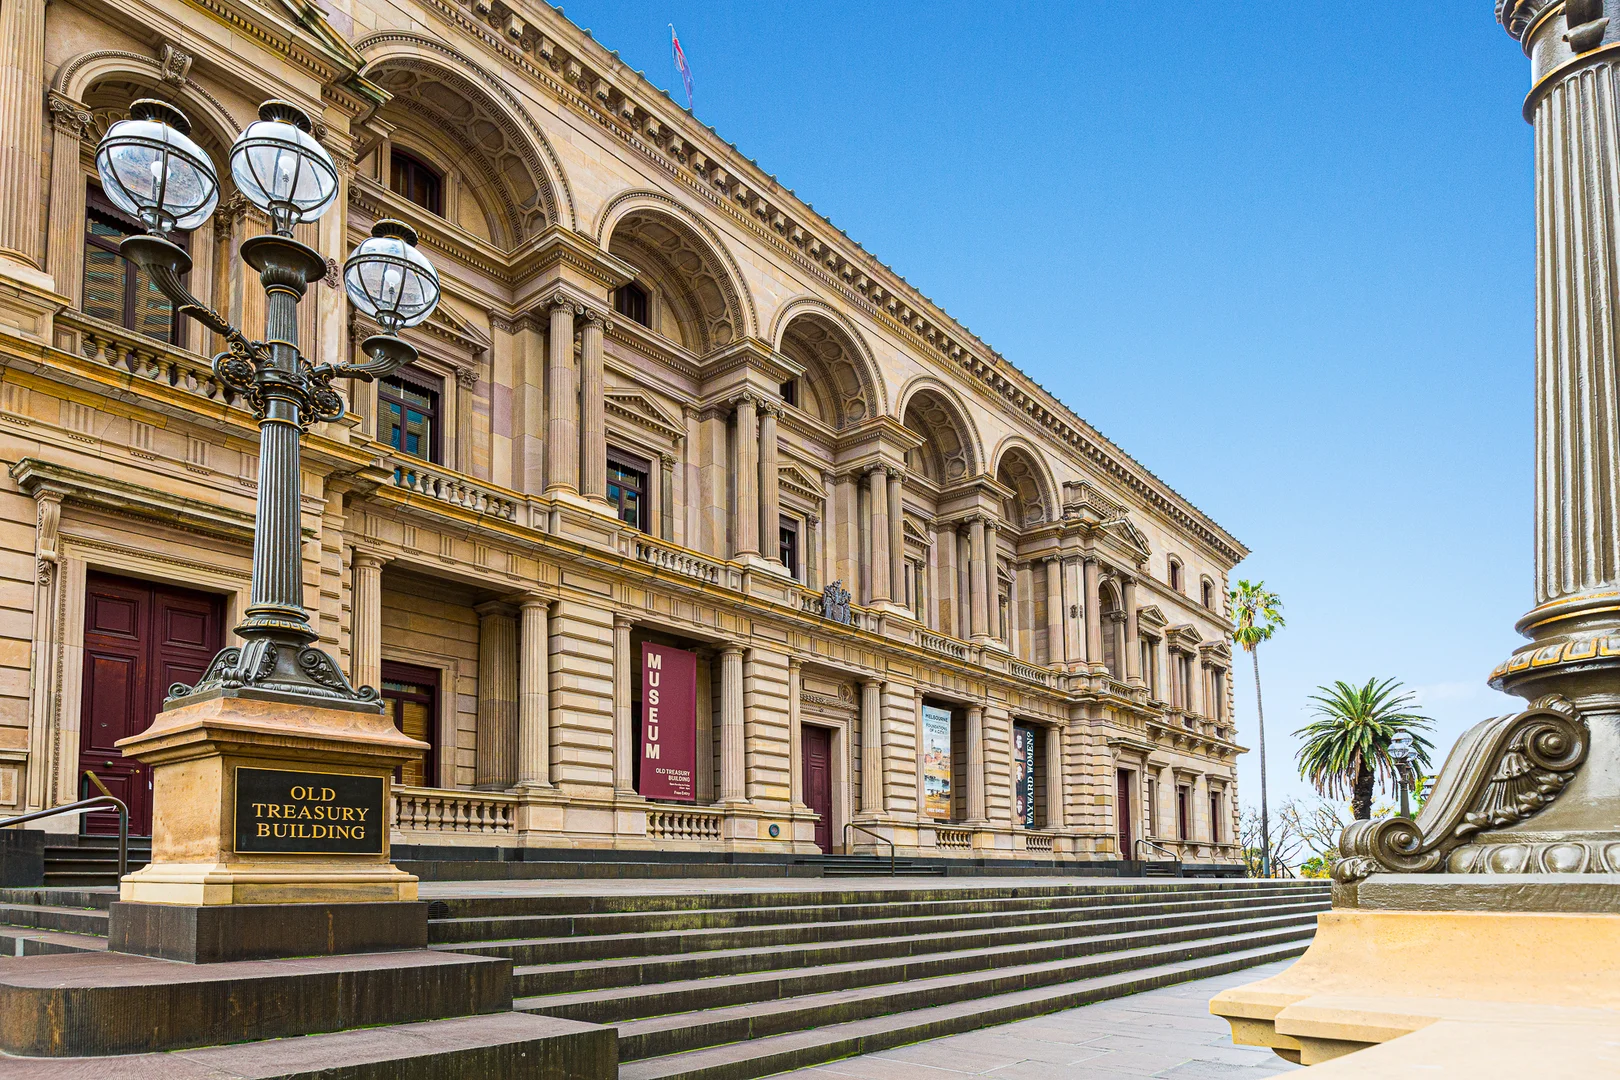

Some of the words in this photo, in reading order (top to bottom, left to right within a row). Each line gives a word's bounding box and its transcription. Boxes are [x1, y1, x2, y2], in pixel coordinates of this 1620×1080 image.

[645, 653, 662, 759] MUSEUM
[925, 714, 948, 722] MELBOURNE
[926, 723, 948, 731] FOUNDATIONS
[290, 785, 336, 801] OLD
[252, 803, 369, 821] TREASURY
[256, 822, 365, 839] BUILDING
